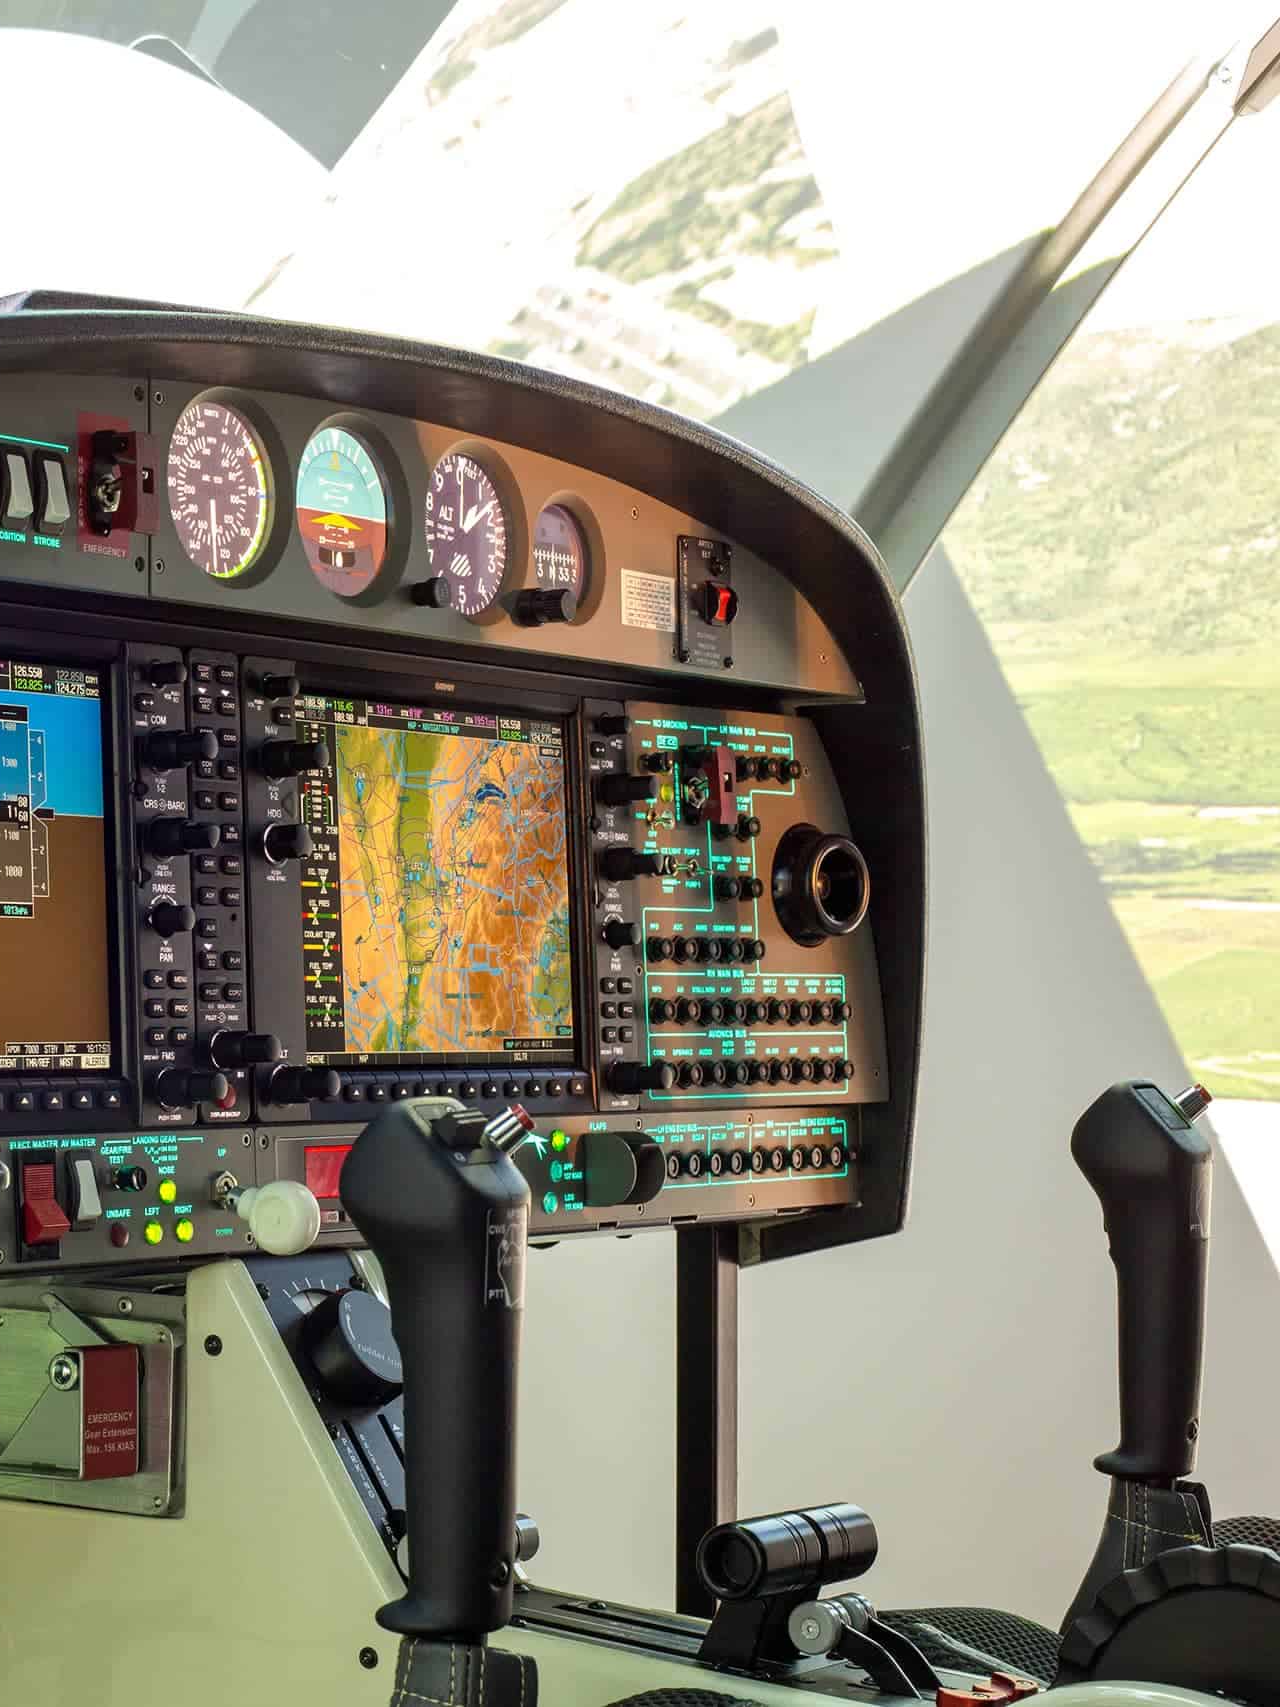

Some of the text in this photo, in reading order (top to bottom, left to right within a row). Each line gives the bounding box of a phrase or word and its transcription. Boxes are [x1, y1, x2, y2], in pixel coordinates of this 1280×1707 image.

[464, 467, 477, 480] FEET
[435, 473, 444, 492] 9
[426, 492, 433, 511] 8
[439, 505, 454, 521] ALT
[33, 536, 61, 548] STROBE
[83, 543, 127, 557] EMERGENCY
[220, 548, 231, 559] 120
[488, 554, 496, 573] 3
[537, 563, 543, 577] 3
[558, 567, 570, 582] 33
[478, 577, 486, 595] 4
[458, 585, 466, 603] 5
[14, 678, 43, 692] 123.825
[56, 681, 85, 697] 124.275
[150, 715, 167, 725] COM
[264, 726, 278, 736] NAV
[2, 756, 18, 768] 1300
[143, 798, 186, 811] CRS BARO
[267, 809, 282, 818] HDG
[4, 829, 20, 841] 1100
[5, 865, 23, 877] 1000
[152, 883, 176, 894] RANGE
[159, 953, 173, 964] PAN
[161, 1051, 175, 1062] FMS
[590, 1121, 608, 1131] FLAPS
[31, 1139, 58, 1149] MASTER
[60, 1138, 96, 1148] AV MASTER
[132, 1136, 177, 1145] LANDING GEAR
[217, 1148, 227, 1158] UP
[109, 1155, 124, 1165] TEST
[158, 1165, 175, 1174] NOSE
[106, 1209, 131, 1218] UNSAFE
[144, 1207, 160, 1216] LEFT
[174, 1205, 192, 1214] RIGHT
[87, 1412, 133, 1424] EMERGENCY
[84, 1427, 136, 1440] Gear Extension
